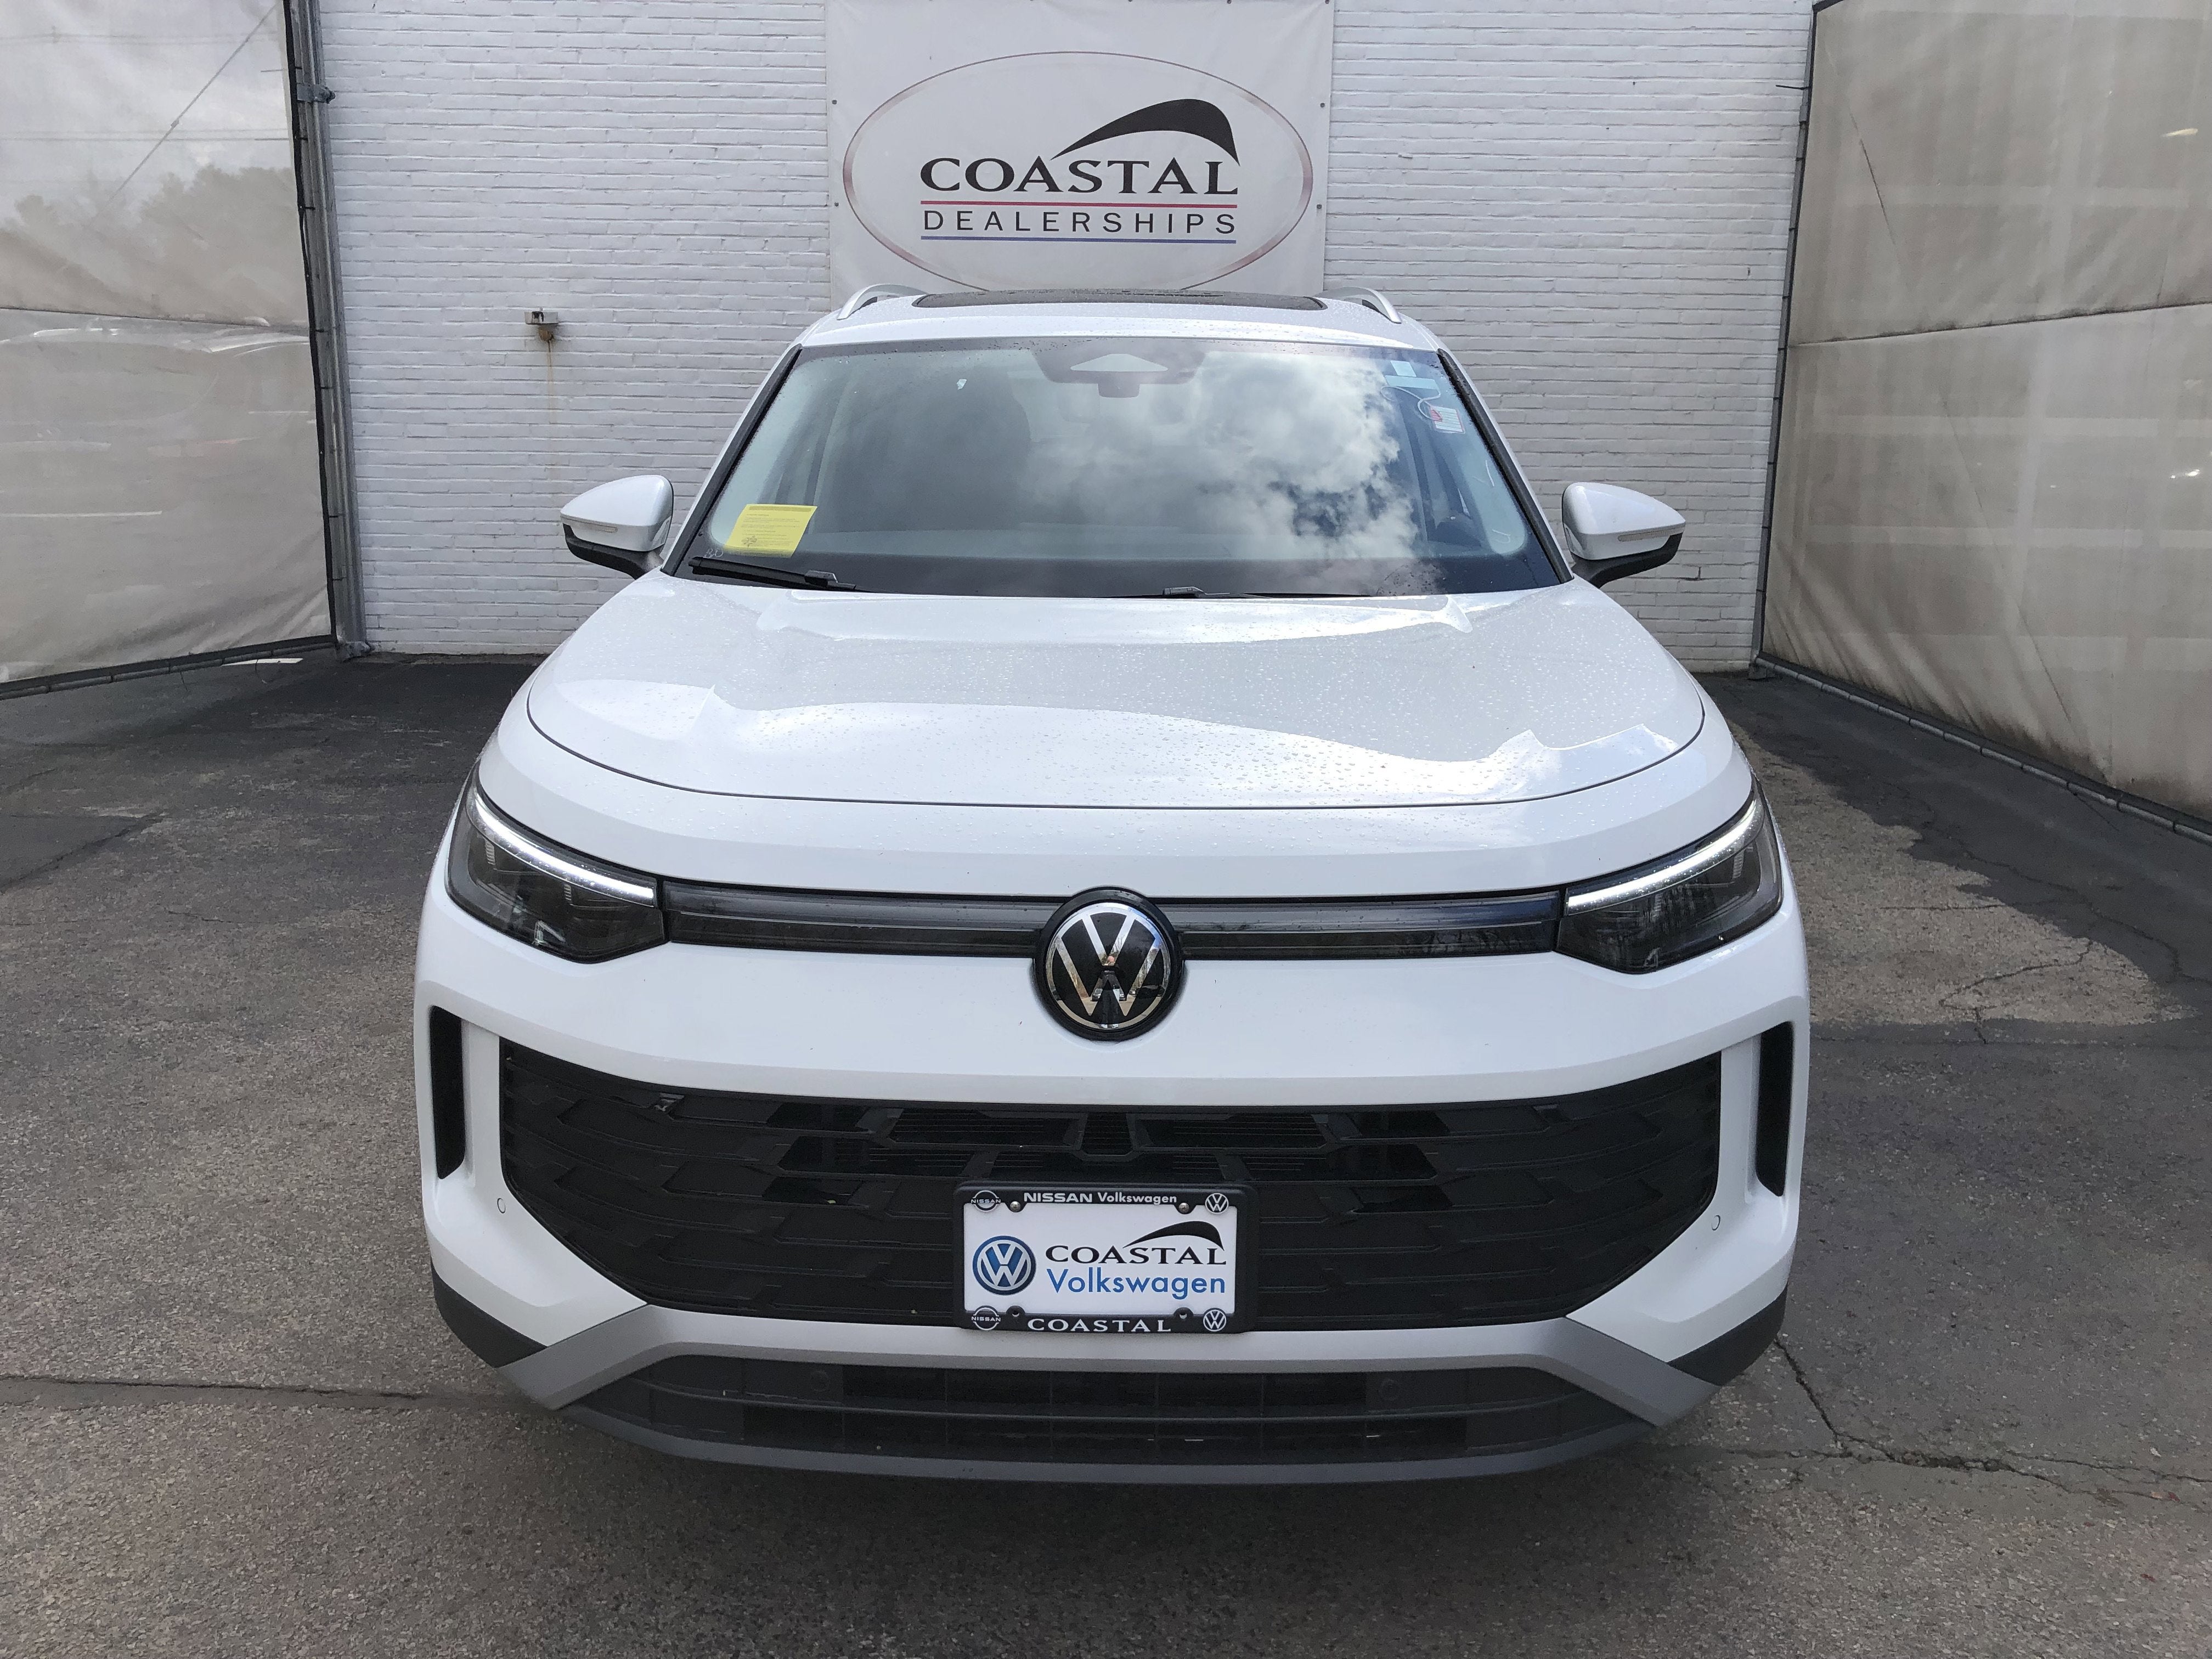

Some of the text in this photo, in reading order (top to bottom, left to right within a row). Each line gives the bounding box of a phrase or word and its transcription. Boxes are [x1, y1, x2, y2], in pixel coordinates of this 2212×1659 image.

[920, 155, 1238, 195] COASTAL
[924, 210, 1235, 234] DEALERSHIPS
[1024, 1192, 1177, 1205] NISSAN Volkswagen
[1045, 1245, 1227, 1265] COASTAL
[1046, 1267, 1225, 1300] Volkswagen
[1028, 1318, 1171, 1333] COASTAL
